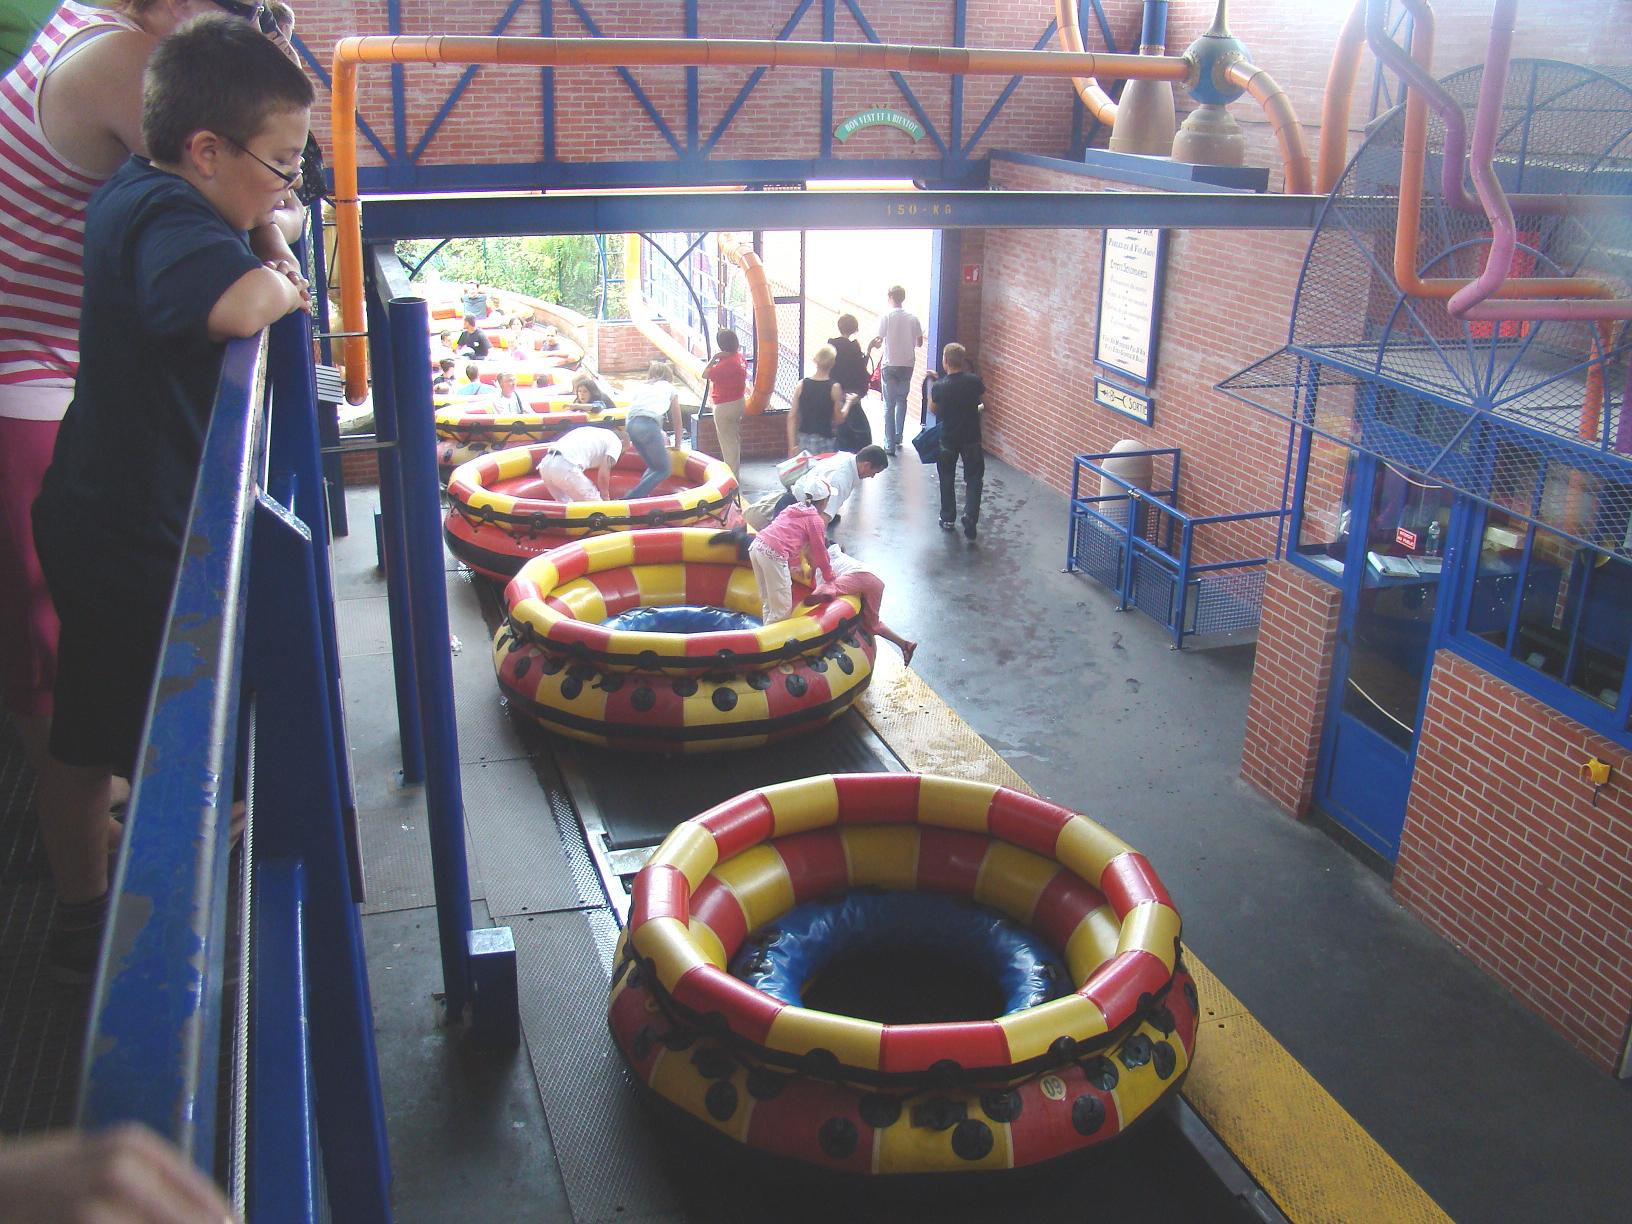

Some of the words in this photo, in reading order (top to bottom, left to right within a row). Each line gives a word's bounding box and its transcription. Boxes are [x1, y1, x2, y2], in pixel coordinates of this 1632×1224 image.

[844, 119, 859, 132] BON
[858, 113, 876, 125] VENT
[876, 112, 885, 121] ET
